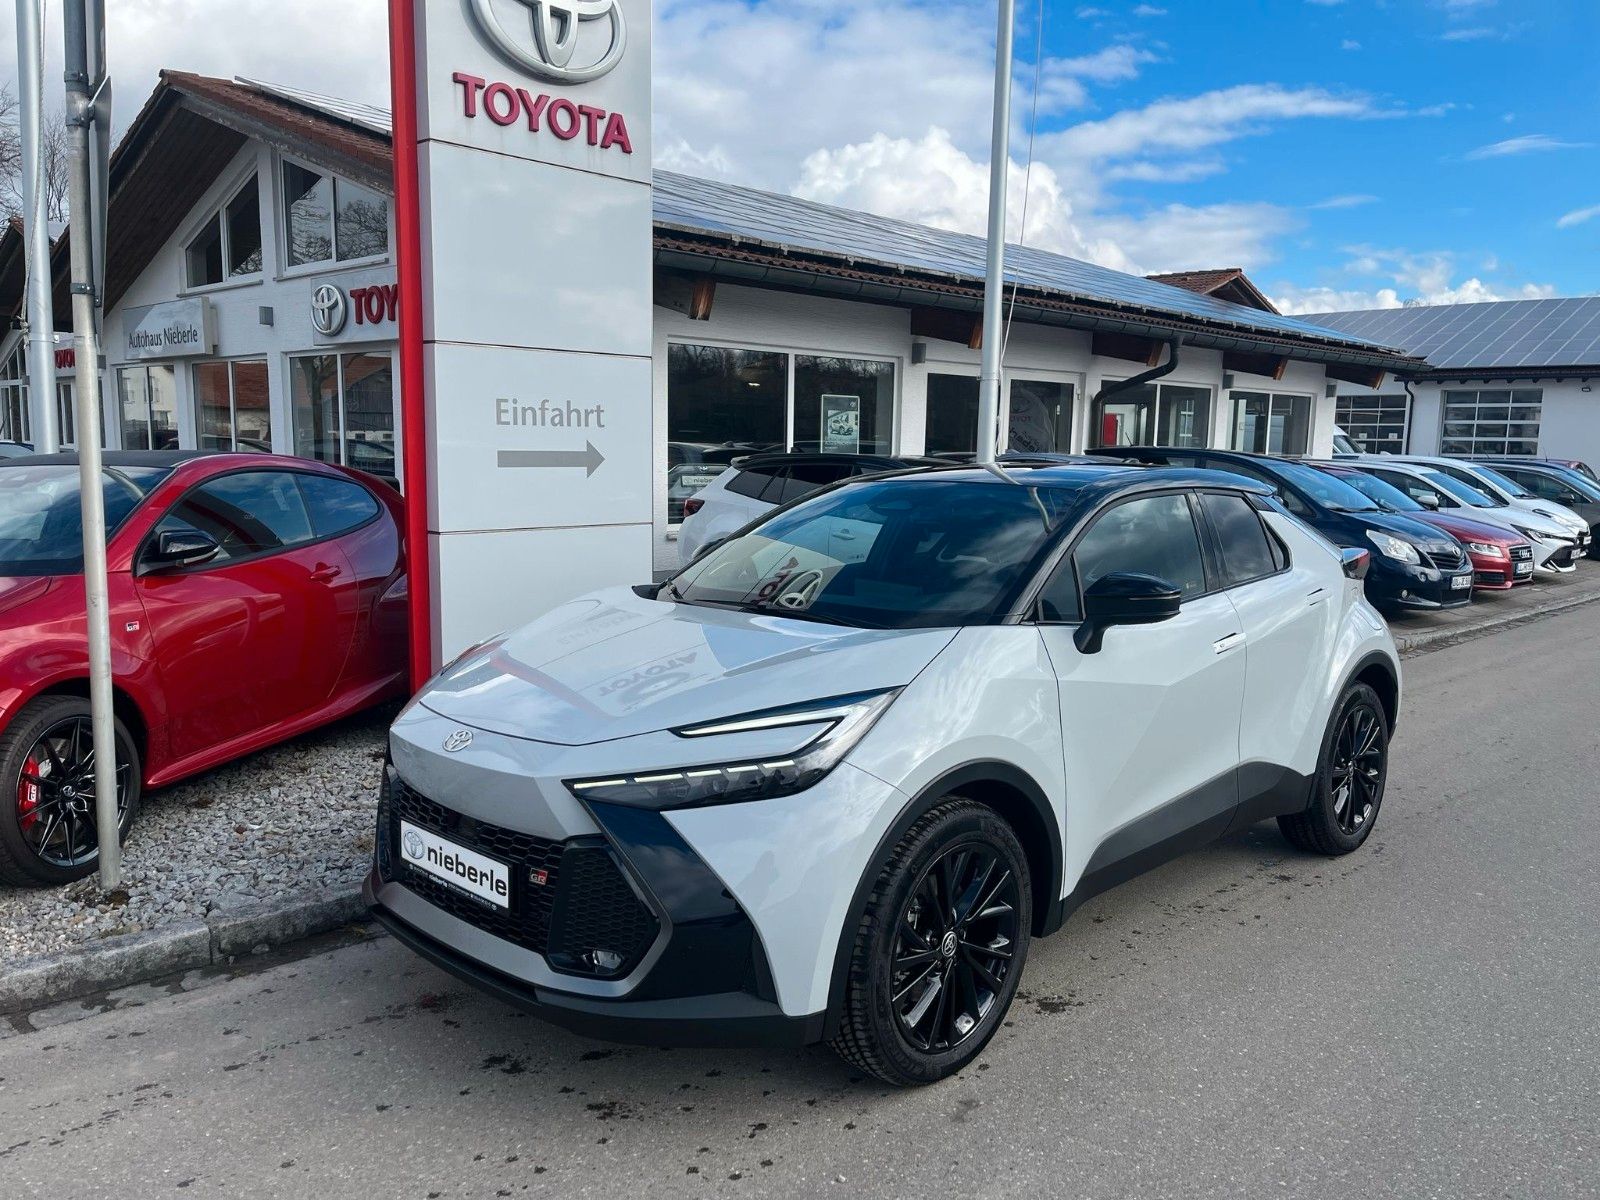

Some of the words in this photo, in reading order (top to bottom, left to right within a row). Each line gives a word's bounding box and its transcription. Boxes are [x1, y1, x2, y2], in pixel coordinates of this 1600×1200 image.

[453, 72, 633, 154] TOYOTA
[349, 284, 399, 325] TOY
[128, 330, 163, 349] Autohaus
[163, 324, 199, 345] Nieberle
[495, 398, 606, 428] Einfahrt
[427, 845, 508, 897] nieberle
[529, 873, 546, 885] GR
